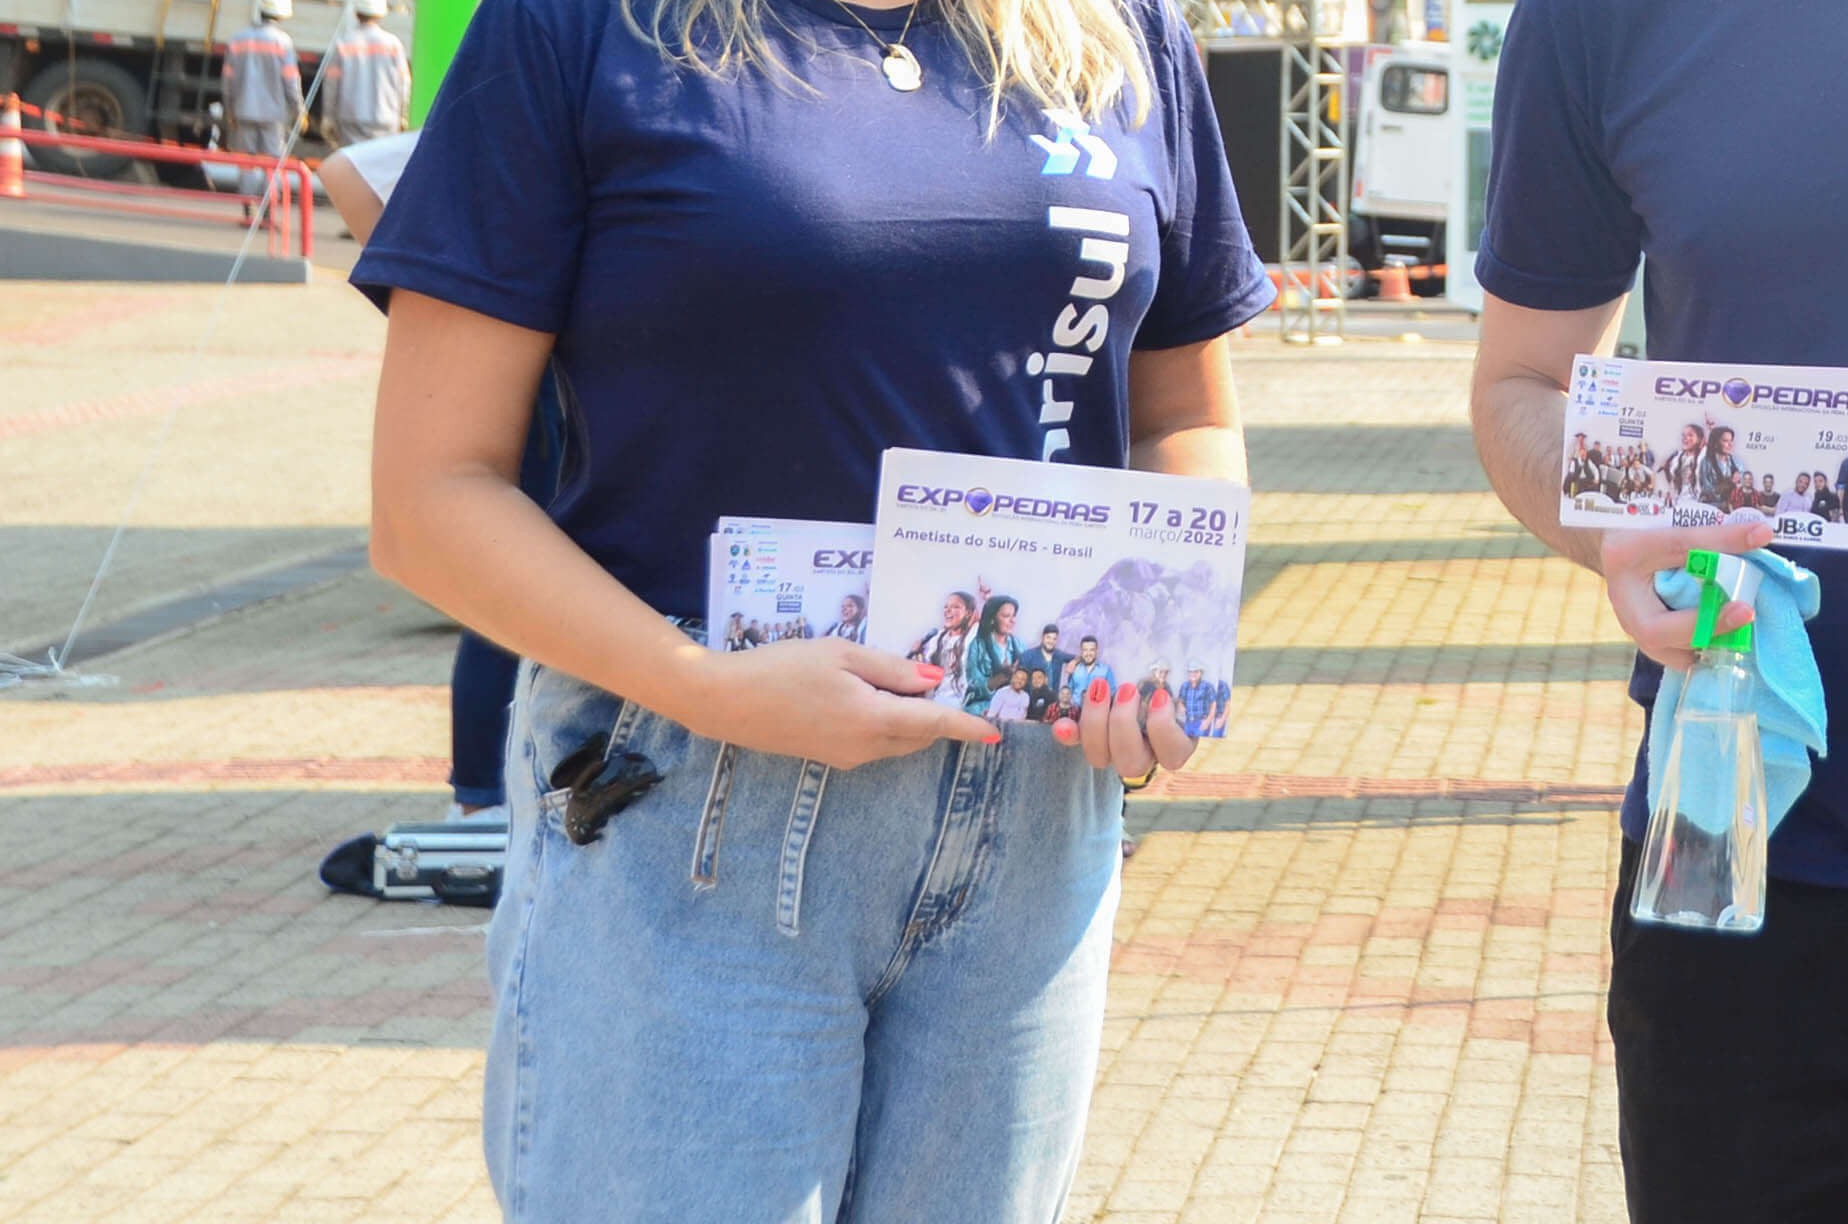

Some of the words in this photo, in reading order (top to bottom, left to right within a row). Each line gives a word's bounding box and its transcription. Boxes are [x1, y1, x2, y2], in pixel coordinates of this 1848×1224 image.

[1748, 431, 1762, 443] 18
[1818, 431, 1833, 443] 19
[1129, 500, 1159, 525] 17
[1166, 509, 1182, 527] a
[1190, 507, 1227, 532] 20
[894, 526, 960, 545] Ametista
[964, 534, 984, 547] do
[988, 536, 1038, 554] Sul/RS
[1052, 543, 1093, 558] Brasil
[1129, 526, 1225, 547] março/2022
[813, 549, 873, 569] EXP
